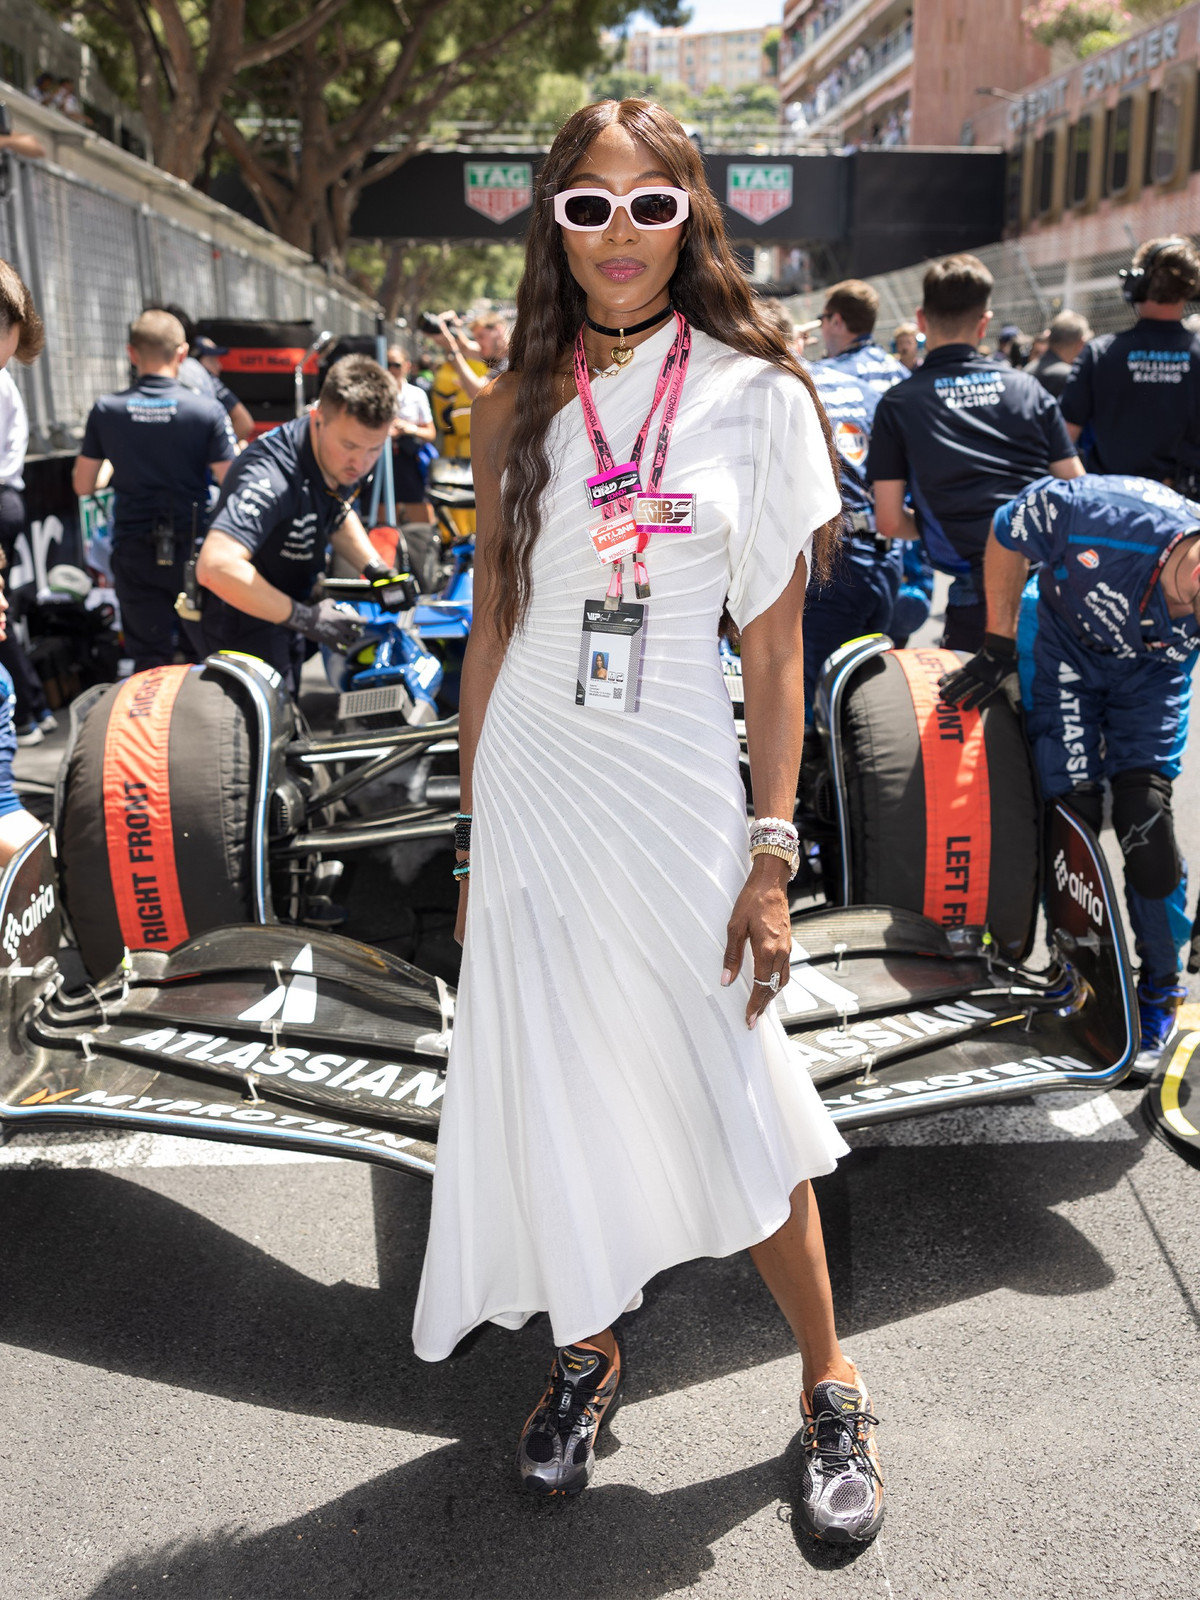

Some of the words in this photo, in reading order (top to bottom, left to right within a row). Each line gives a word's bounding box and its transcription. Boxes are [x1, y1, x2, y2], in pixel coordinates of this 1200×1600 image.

[1081, 21, 1180, 98] FONCIER
[467, 165, 527, 188] TAG
[732, 167, 786, 189] TAG
[730, 190, 791, 222] HEUER
[1127, 350, 1192, 362] ATLASSIAN
[1127, 361, 1191, 373] WILLIAMS
[934, 371, 1002, 389] ATLASSIAN
[1132, 371, 1183, 383] RACING
[935, 382, 1006, 400] WILLIAMS
[944, 393, 1000, 410] RACING
[664, 394, 679, 424] MONACO
[654, 452, 665, 468] VIP
[606, 488, 627, 501] MONACO
[637, 500, 673, 512] GRID
[645, 511, 674, 524] VIP
[597, 531, 613, 544] PIT
[612, 522, 636, 540] LANE
[608, 548, 627, 560] MONACO
[586, 612, 601, 621] VIP
[124, 779, 156, 862] FRONT
[944, 836, 971, 893] LEFT
[22, 884, 55, 936] airia
[133, 871, 170, 945] RIGHT
[1069, 872, 1104, 927] airia
[120, 1028, 447, 1107] ATLASSIAN
[822, 1054, 1094, 1110] YPROTEIN
[73, 1090, 417, 1149] MYPROTEIN
